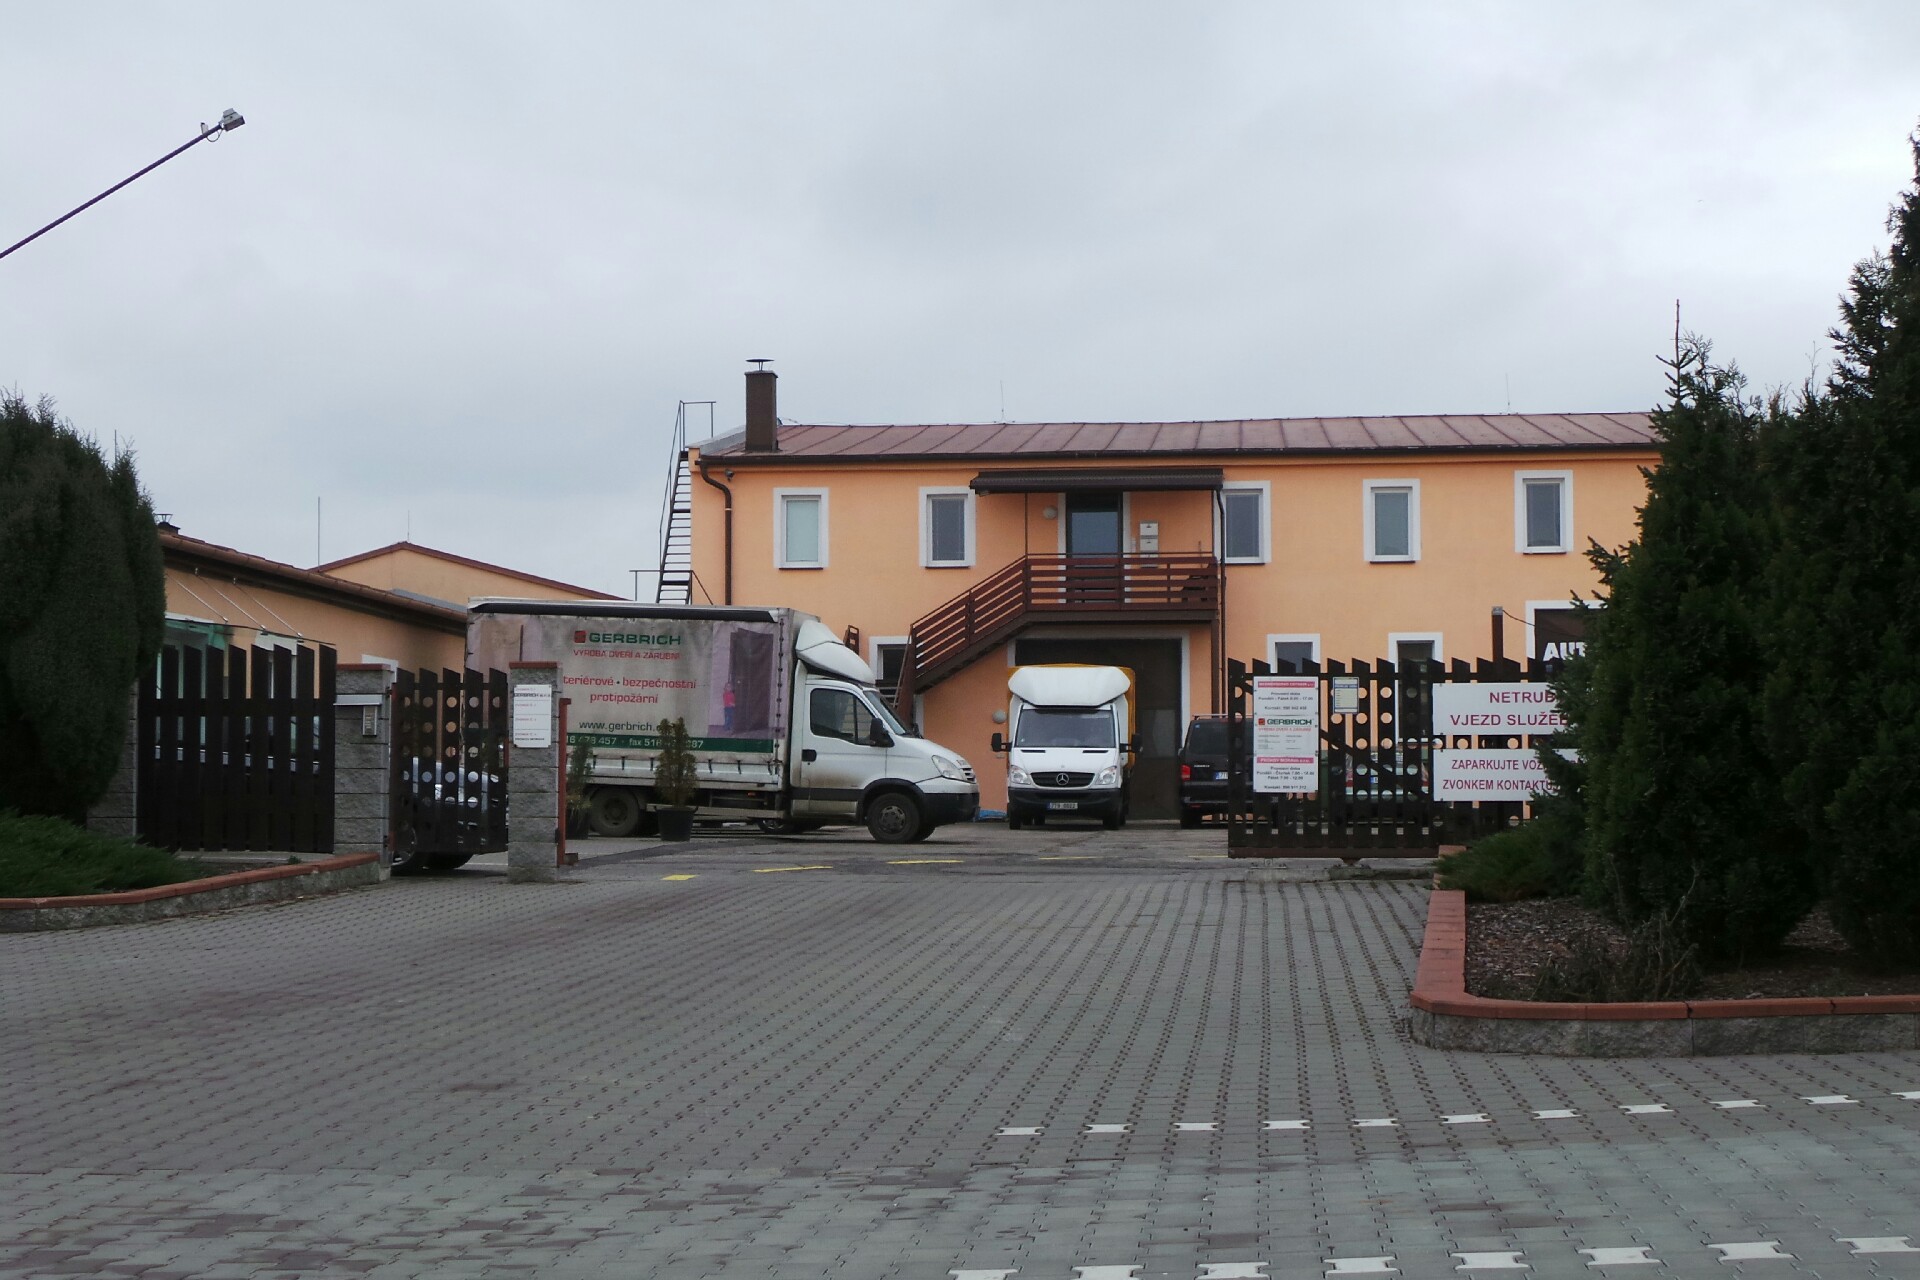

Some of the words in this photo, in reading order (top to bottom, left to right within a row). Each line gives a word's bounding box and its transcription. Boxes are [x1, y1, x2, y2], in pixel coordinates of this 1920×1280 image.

[588, 632, 682, 646] GERBRICH
[1542, 641, 1588, 662] AUT
[563, 675, 614, 686] teriérové
[622, 677, 697, 690] bezpečnostní
[590, 692, 659, 705] protipožární
[1489, 691, 1556, 704] NETRUB
[579, 720, 662, 732] www.gerbrich.c
[1266, 718, 1312, 726] GERBRICH
[1450, 714, 1502, 726] VJEZD
[598, 736, 617, 745] 457
[628, 738, 642, 746] fax
[1451, 759, 1519, 770] ZAPARKUJTE
[1522, 759, 1543, 770] VOZ
[1443, 779, 1494, 790] ZVONKEM
[1496, 779, 1559, 791] KONTAKTU
